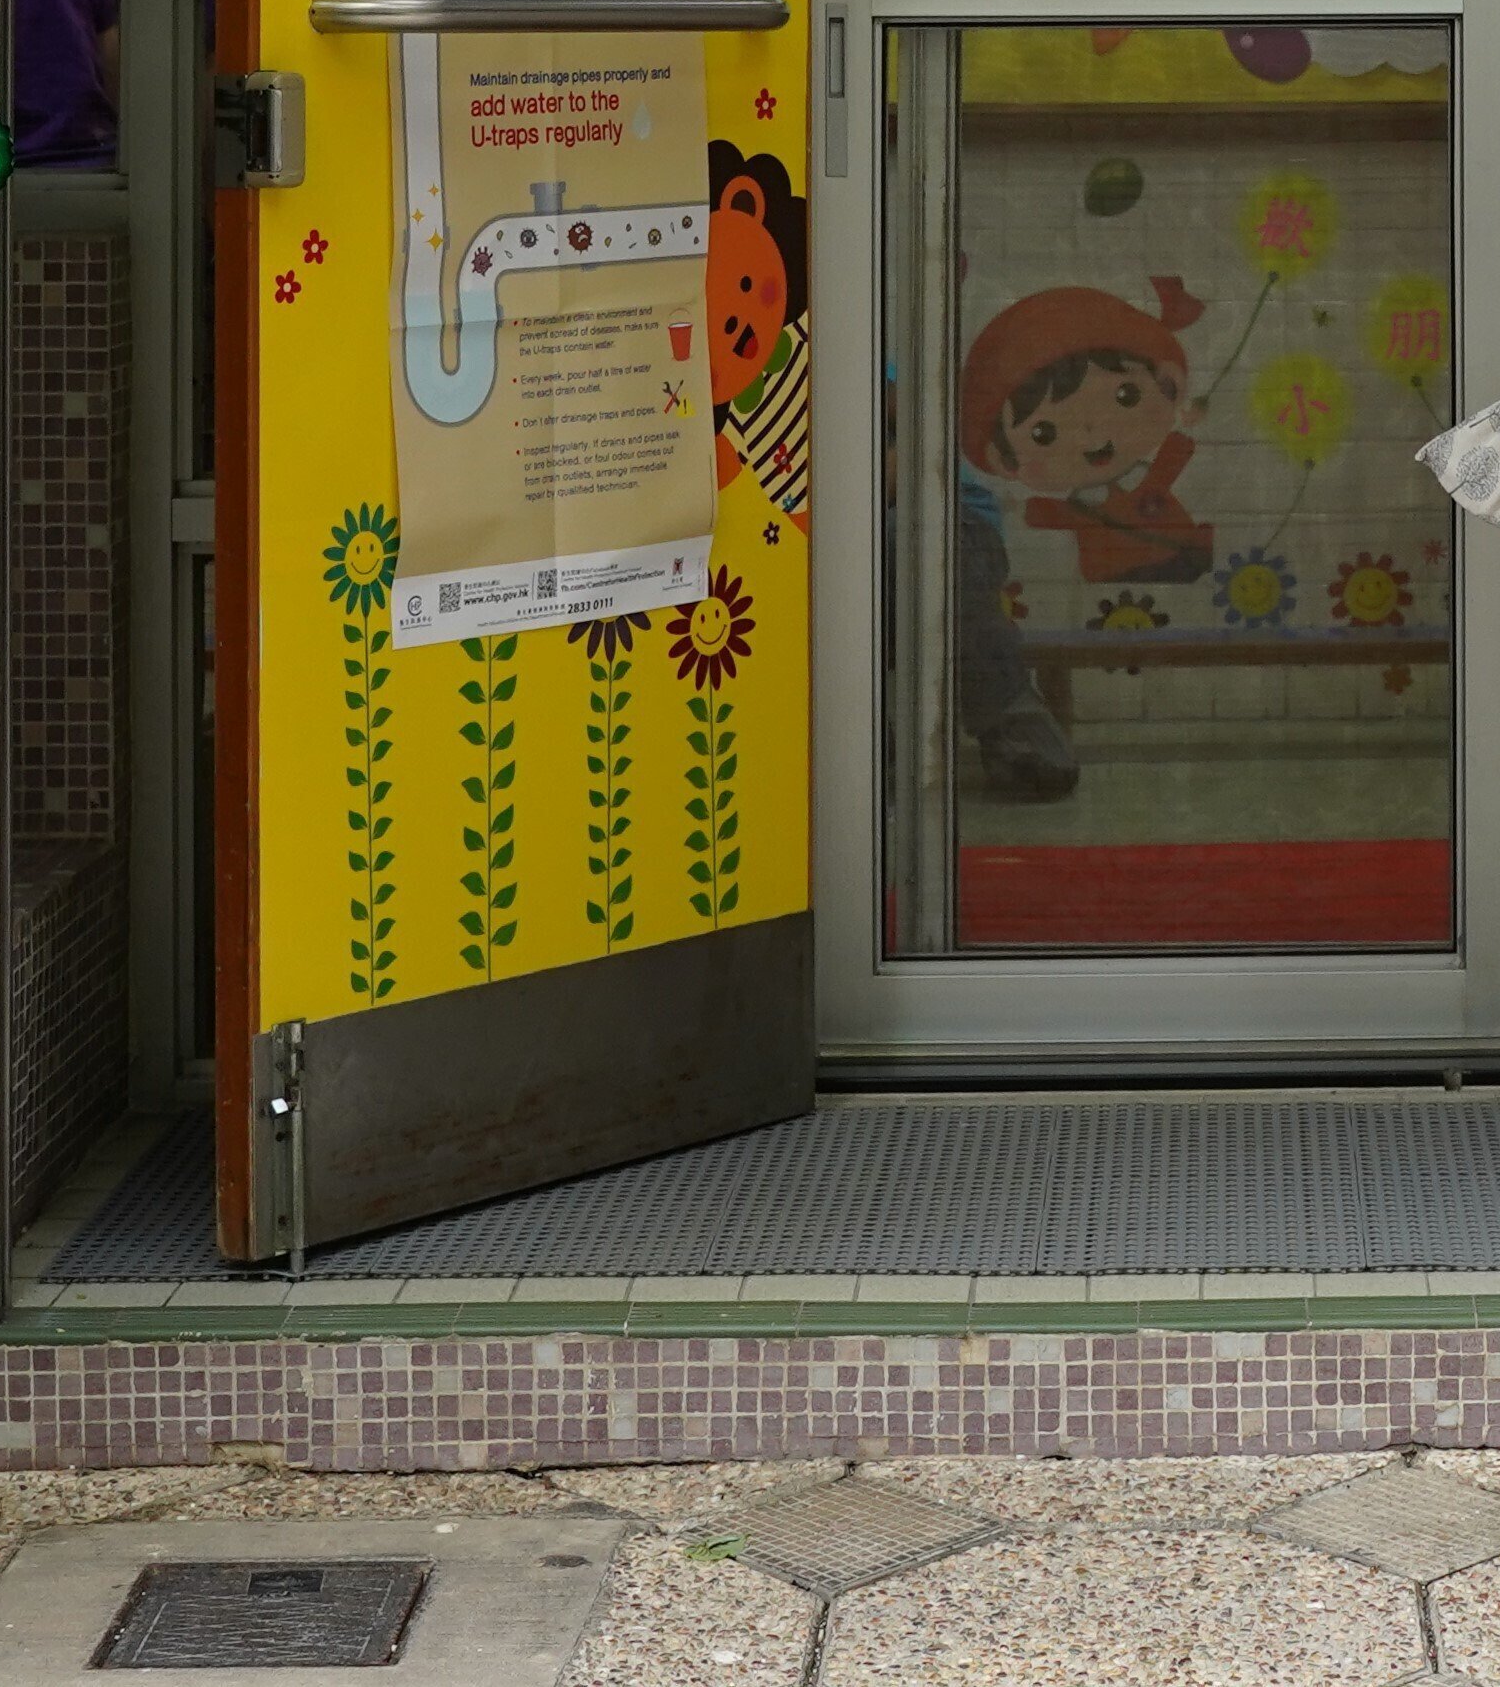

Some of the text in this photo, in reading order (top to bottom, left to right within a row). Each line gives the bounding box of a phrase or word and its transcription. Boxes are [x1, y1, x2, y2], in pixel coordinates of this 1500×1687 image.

[470, 66, 671, 87] Maintain drainage pipes properly and
[471, 90, 619, 116] add water to the
[471, 119, 623, 150] U-traps regularly
[1387, 308, 1442, 361] 朋
[1277, 384, 1331, 435] 小
[463, 588, 529, 607] www.chp.gov.hk
[568, 600, 591, 615] 2833
[593, 597, 614, 611] 0111
